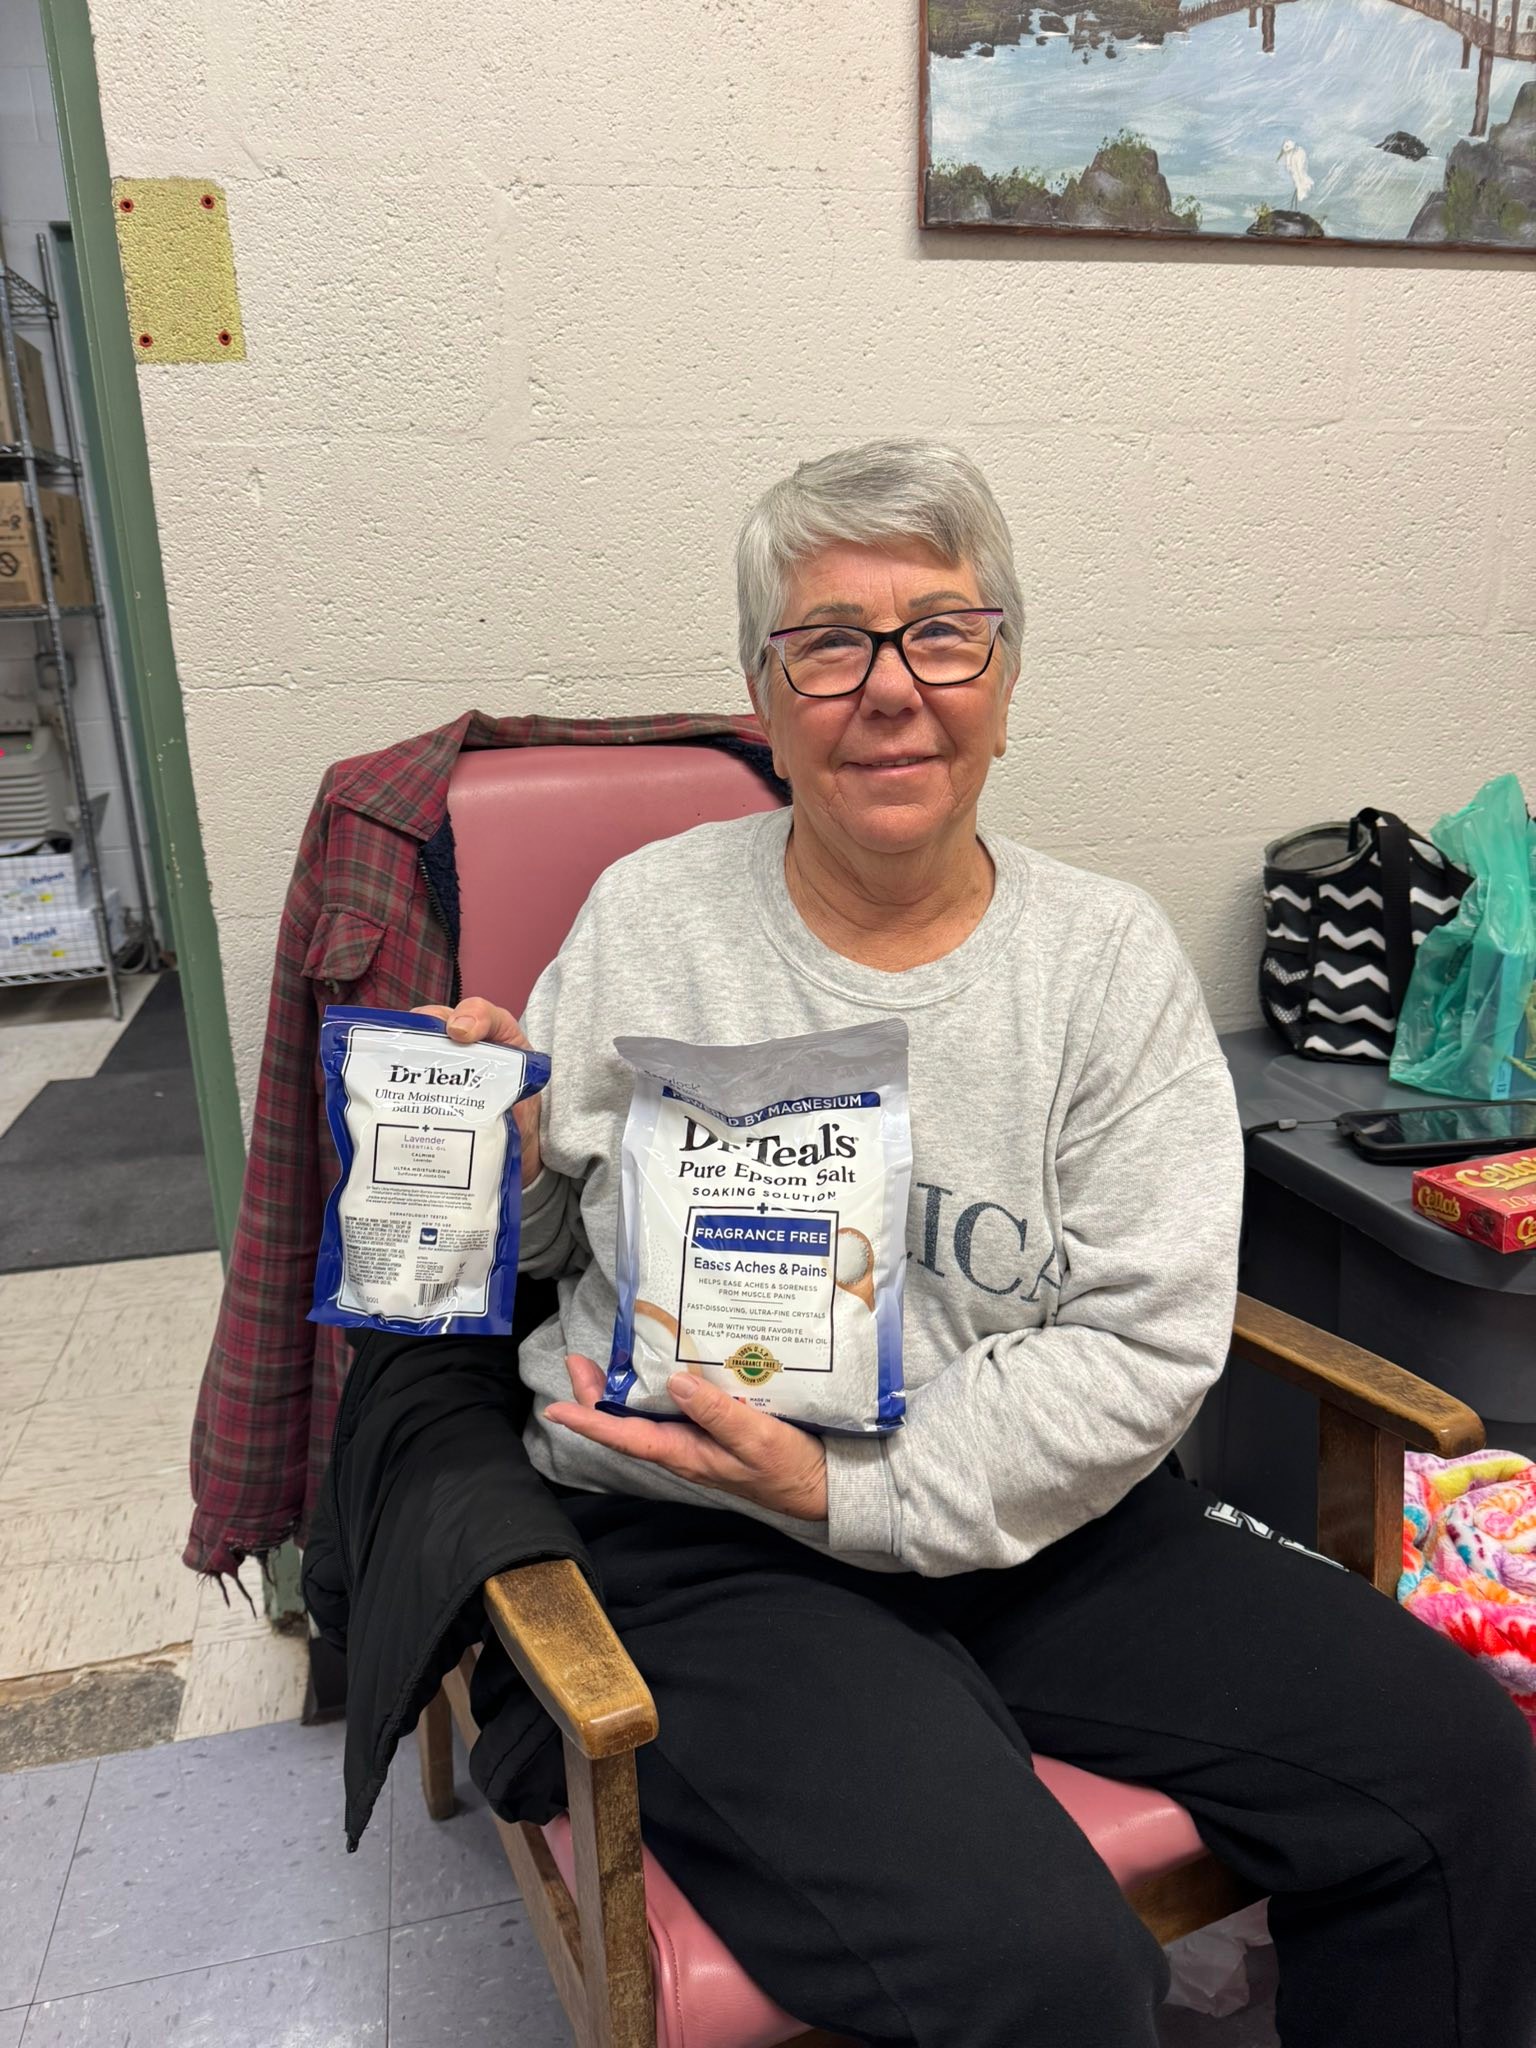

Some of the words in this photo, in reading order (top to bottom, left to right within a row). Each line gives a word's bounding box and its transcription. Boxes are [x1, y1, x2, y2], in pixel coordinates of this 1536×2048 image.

[388, 1064, 421, 1084] Dr
[424, 1067, 482, 1089] Teal's
[375, 1089, 404, 1100] Ultra
[407, 1091, 485, 1109] Moisturizing
[392, 1101, 419, 1114] Bath
[422, 1105, 464, 1117] Bombs
[744, 1111, 765, 1127] BY
[768, 1095, 863, 1117] MAGNESIUM
[404, 1135, 446, 1145] Lavender
[679, 1115, 741, 1153] Dr
[746, 1123, 857, 1167] Teal's
[678, 1161, 726, 1179] Pure
[734, 1162, 807, 1187] Epsom
[816, 1166, 856, 1186] Salt
[692, 1187, 756, 1197] SOAKING
[763, 1191, 836, 1204] SOLUTION
[1418, 1185, 1460, 1218] Cella's
[1500, 1196, 1528, 1208] 10
[695, 1228, 785, 1242] FRAGRANCE
[790, 1231, 828, 1244] FREE
[694, 1257, 731, 1271] Eases
[734, 1260, 776, 1274] Aches
[779, 1263, 788, 1275] &
[791, 1263, 827, 1277] Pains
[744, 1281, 769, 1289] ACHES
[779, 1283, 818, 1292] SORENESS
[742, 1291, 771, 1299] MUSCLE
[687, 1303, 747, 1315] FAST-DISSOLVING,
[749, 1309, 790, 1317] ULTRA-FINE
[792, 1311, 826, 1319] CRYSTALS
[726, 1332, 759, 1340] FOAMING
[768, 1327, 803, 1335] FAVORITE
[732, 1359, 761, 1367] FRAGRANCE
[763, 1361, 775, 1369] FREE
